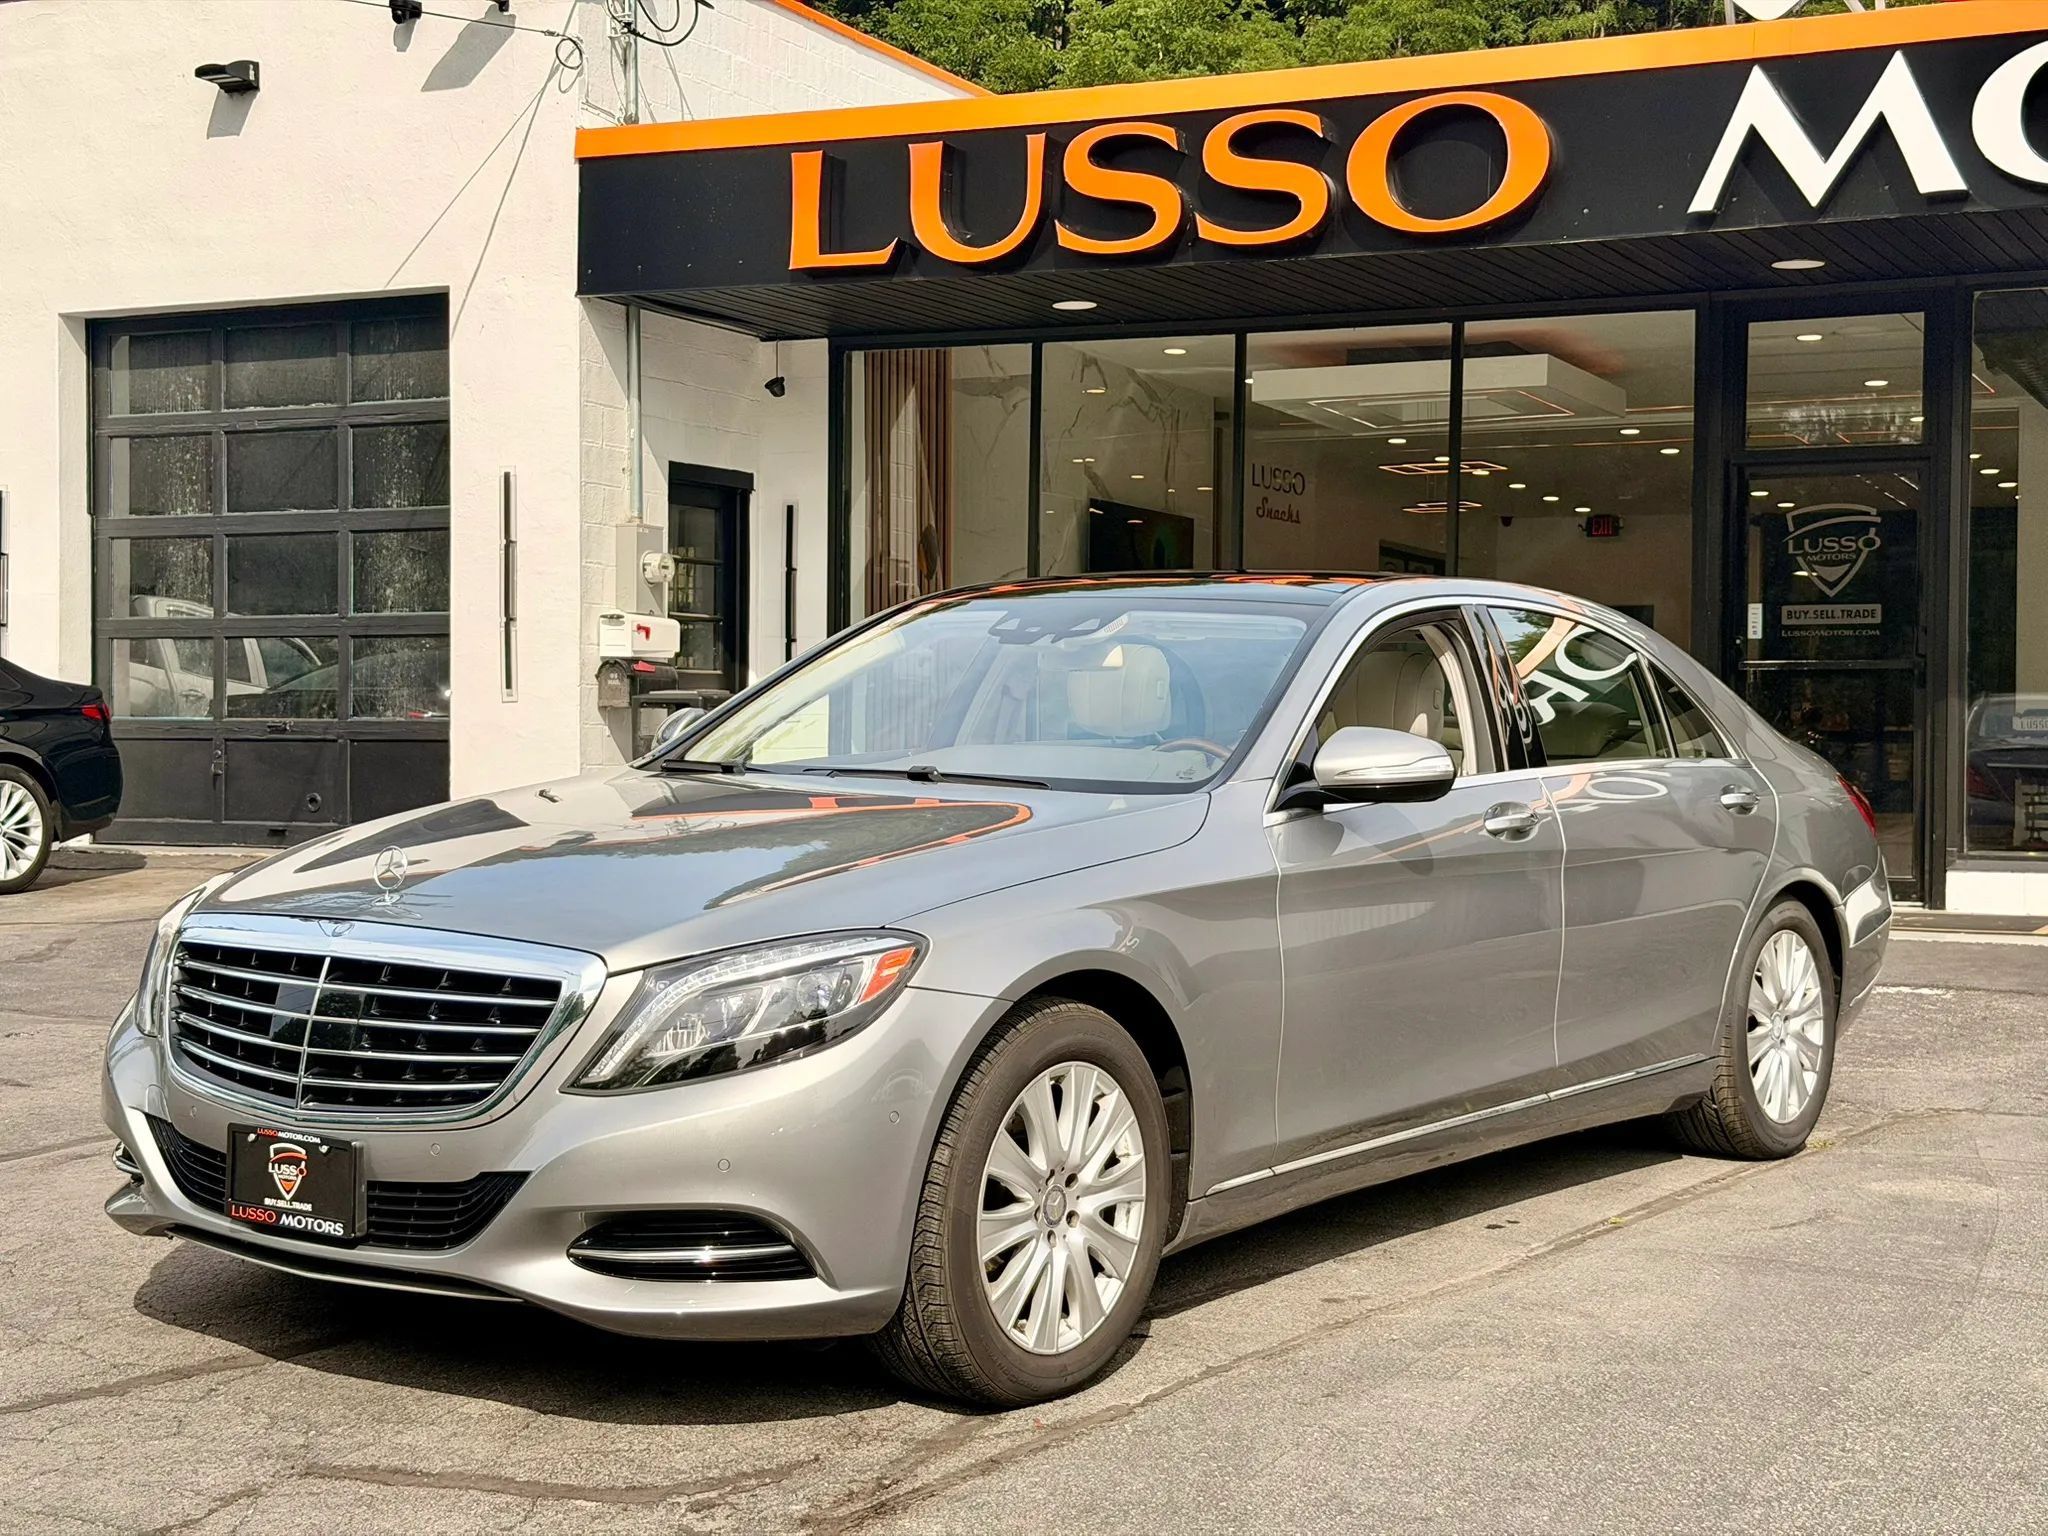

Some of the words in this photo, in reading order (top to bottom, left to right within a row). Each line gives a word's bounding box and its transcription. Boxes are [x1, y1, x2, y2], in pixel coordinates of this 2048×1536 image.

[788, 90, 1551, 271] LUSSO
[1251, 463, 1306, 496] LUSSO
[1256, 496, 1302, 524] Snacks
[1787, 535, 1882, 554] LUSSO
[1806, 553, 1857, 561] MOTORS
[257, 1128, 321, 1143] LUSSOMOTOR.COM
[268, 1162, 307, 1176] LUSSO
[231, 1203, 277, 1224] LUSSO
[279, 1213, 344, 1236] MOTORS
